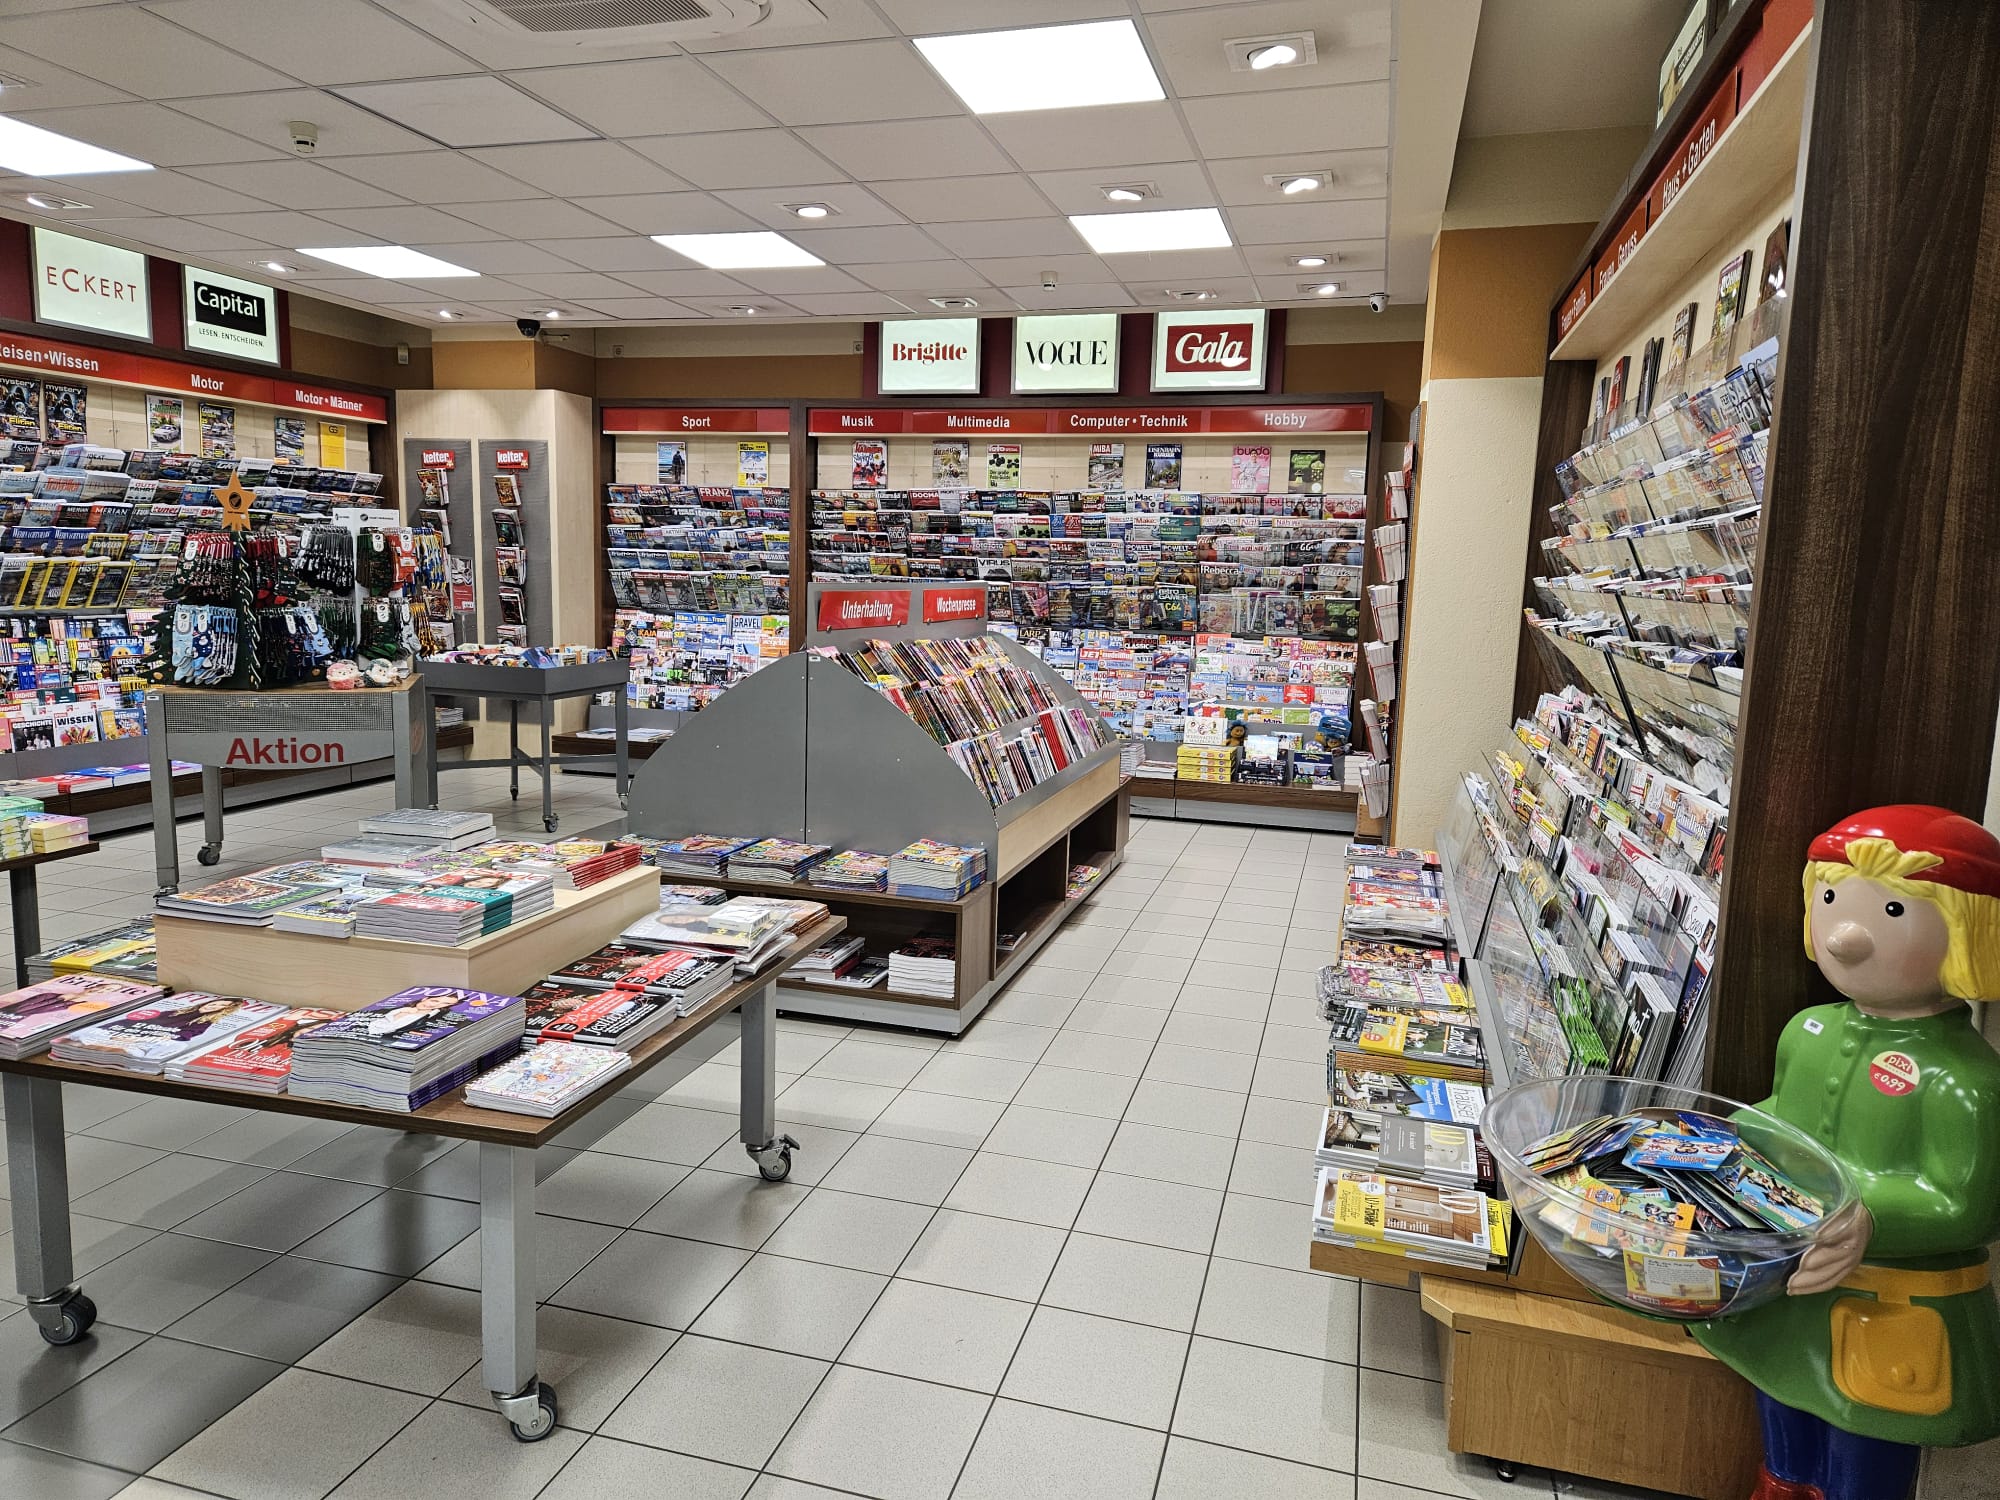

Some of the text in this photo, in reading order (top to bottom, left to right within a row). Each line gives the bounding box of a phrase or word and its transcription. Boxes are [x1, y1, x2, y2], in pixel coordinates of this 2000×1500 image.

[1689, 119, 1715, 173] Garten
[47, 266, 137, 303] ECKERT
[196, 286, 259, 318] Capital
[198, 327, 265, 347] LESEN. ENTSCHEIDEN.
[892, 342, 968, 365] Brigitte
[1025, 340, 1107, 366] VOGUE
[1175, 331, 1245, 366] Gala
[45, 383, 82, 395] mystery
[191, 374, 224, 391] Motor
[682, 416, 710, 429] Sport
[841, 415, 874, 427] Musik
[947, 416, 1010, 428] Multimedia
[1264, 413, 1307, 428] Hobby
[1093, 444, 1111, 453] MIBA
[423, 451, 449, 464] kelter
[497, 451, 523, 464] kelter
[700, 488, 731, 497] FRANZ
[95, 506, 128, 516] MERIAN
[842, 600, 893, 620] Unterhaltung
[937, 597, 976, 615] Wochenpresse
[734, 617, 761, 629] GRAVEL
[1020, 629, 1040, 637] LARP
[1319, 662, 1349, 672] Anna
[57, 715, 94, 726] WISSEN
[226, 737, 344, 764] Aktion
[400, 987, 510, 1007] DONNA
[1888, 1056, 1912, 1071] pixi
[1455, 1088, 1476, 1120] häuser
